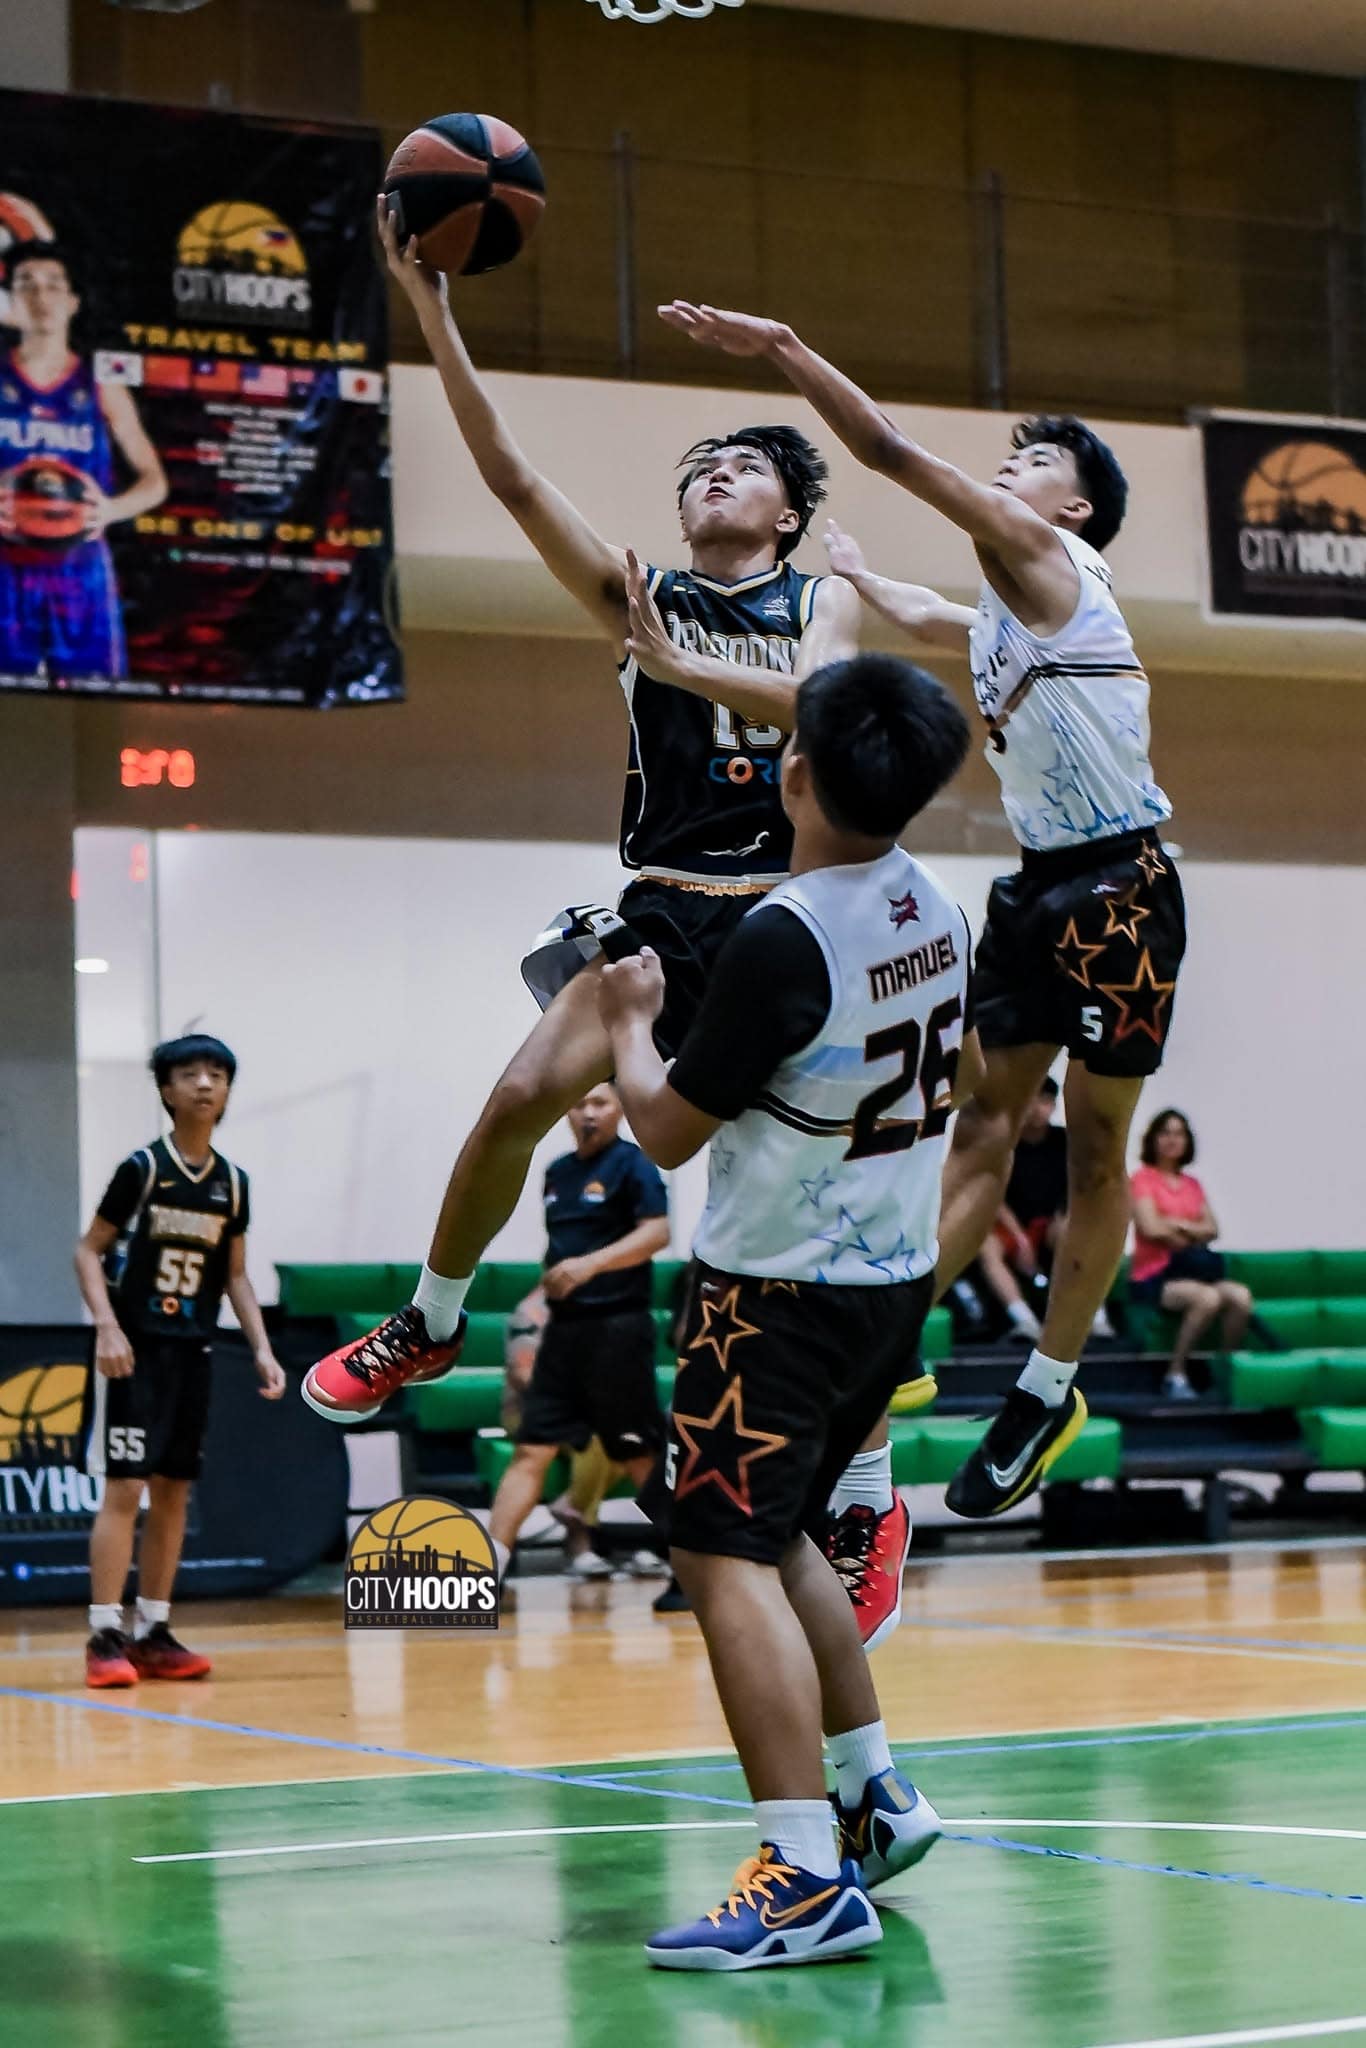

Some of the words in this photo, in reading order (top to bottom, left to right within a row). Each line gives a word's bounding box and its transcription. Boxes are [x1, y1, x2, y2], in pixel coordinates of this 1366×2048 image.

[122, 323, 257, 356] TRAVEL
[268, 336, 367, 362] TEAM
[1080, 1005, 1104, 1043] 5
[842, 992, 961, 1163] 26
[155, 1248, 206, 1298] 55
[109, 1427, 146, 1461] 55
